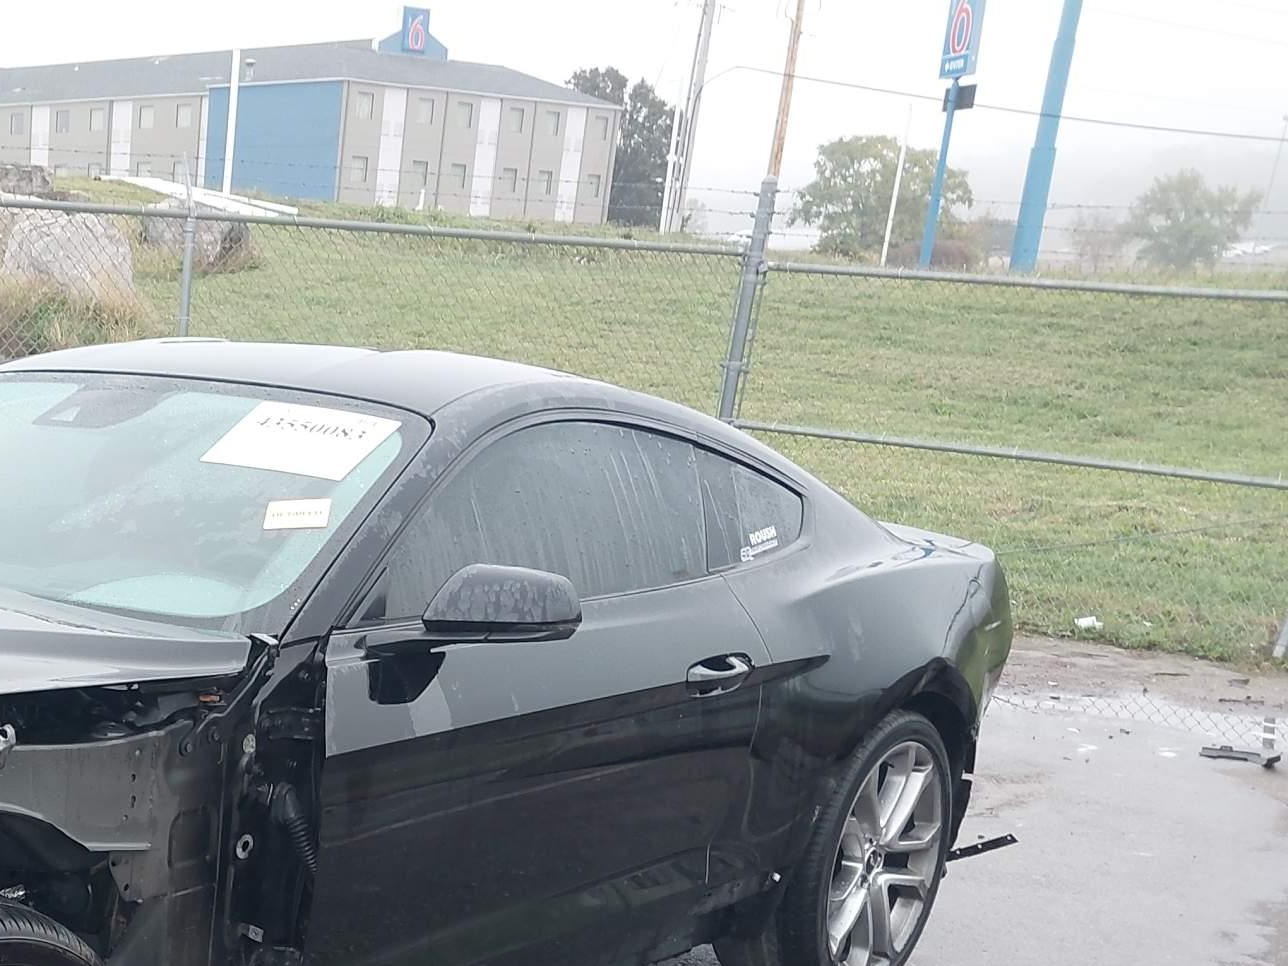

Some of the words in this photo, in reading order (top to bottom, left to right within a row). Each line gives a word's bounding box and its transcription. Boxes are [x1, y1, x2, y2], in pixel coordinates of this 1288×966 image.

[408, 15, 425, 50] 6
[950, 0, 973, 56] 6
[748, 525, 777, 546] ROUSH
